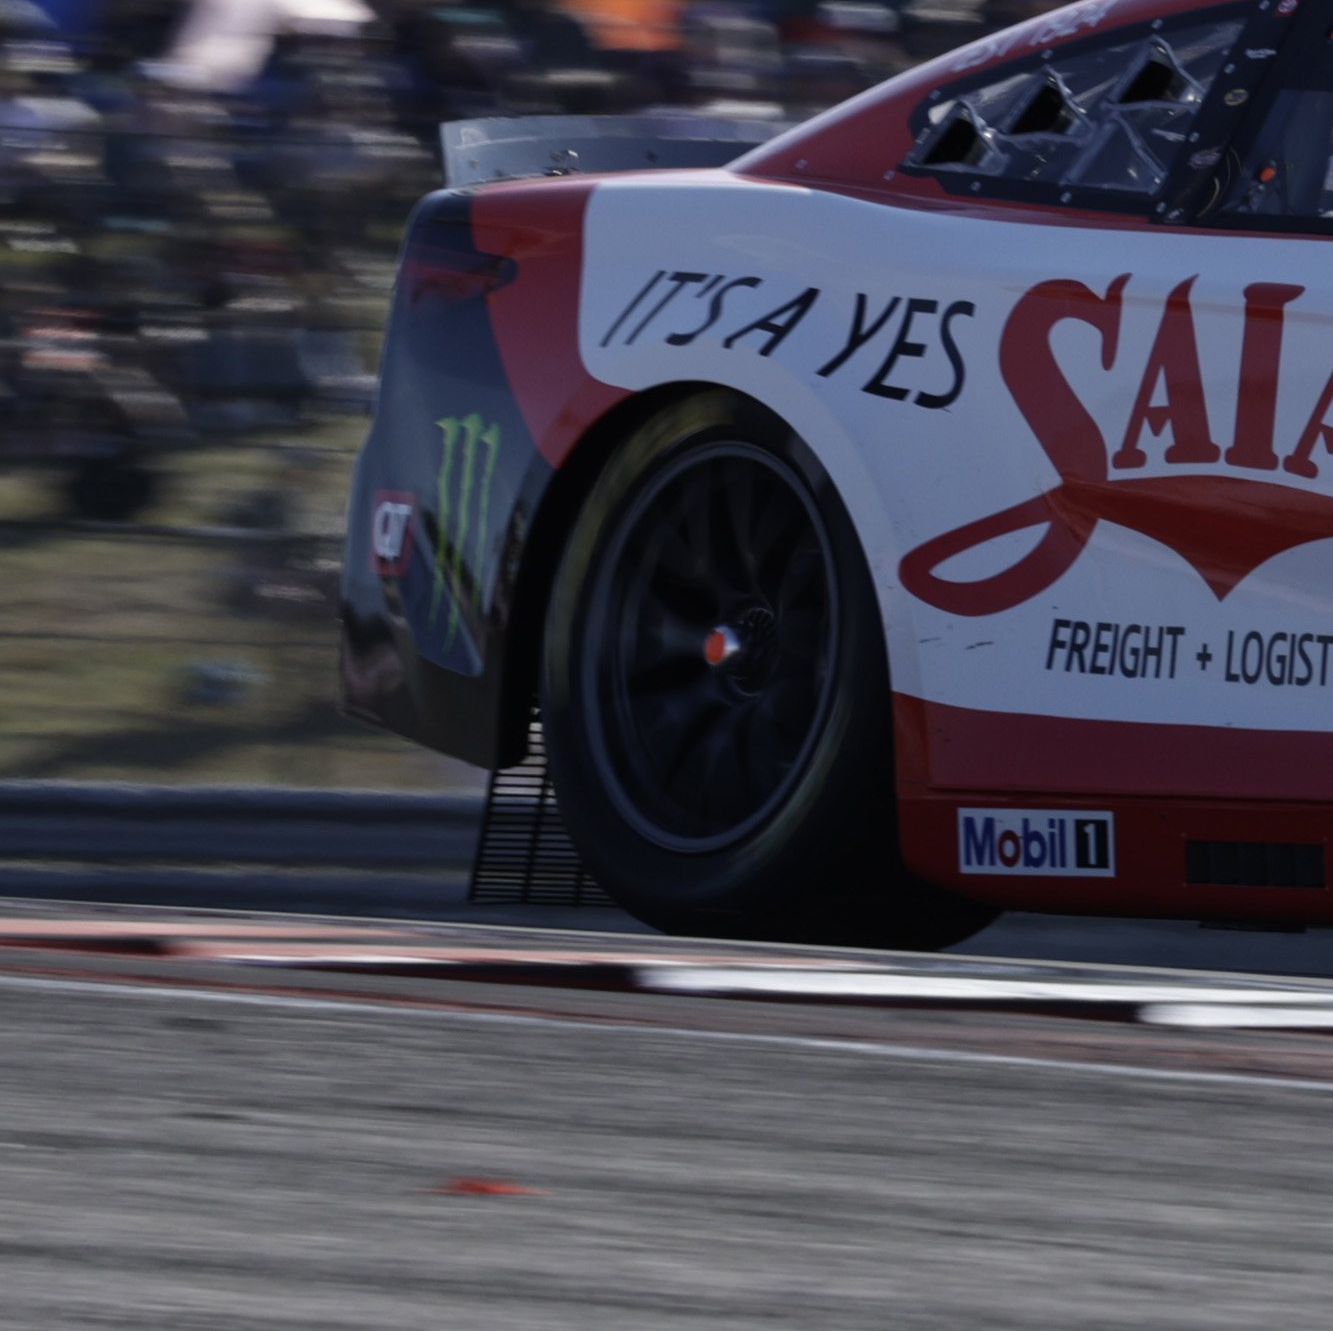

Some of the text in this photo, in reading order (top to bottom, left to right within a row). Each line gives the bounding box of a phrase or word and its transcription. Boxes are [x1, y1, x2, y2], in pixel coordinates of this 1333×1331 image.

[600, 270, 976, 410] IT'S A YES
[372, 500, 413, 562] QT
[1045, 618, 1186, 680] FREIGHT
[963, 816, 1067, 869] Mobil
